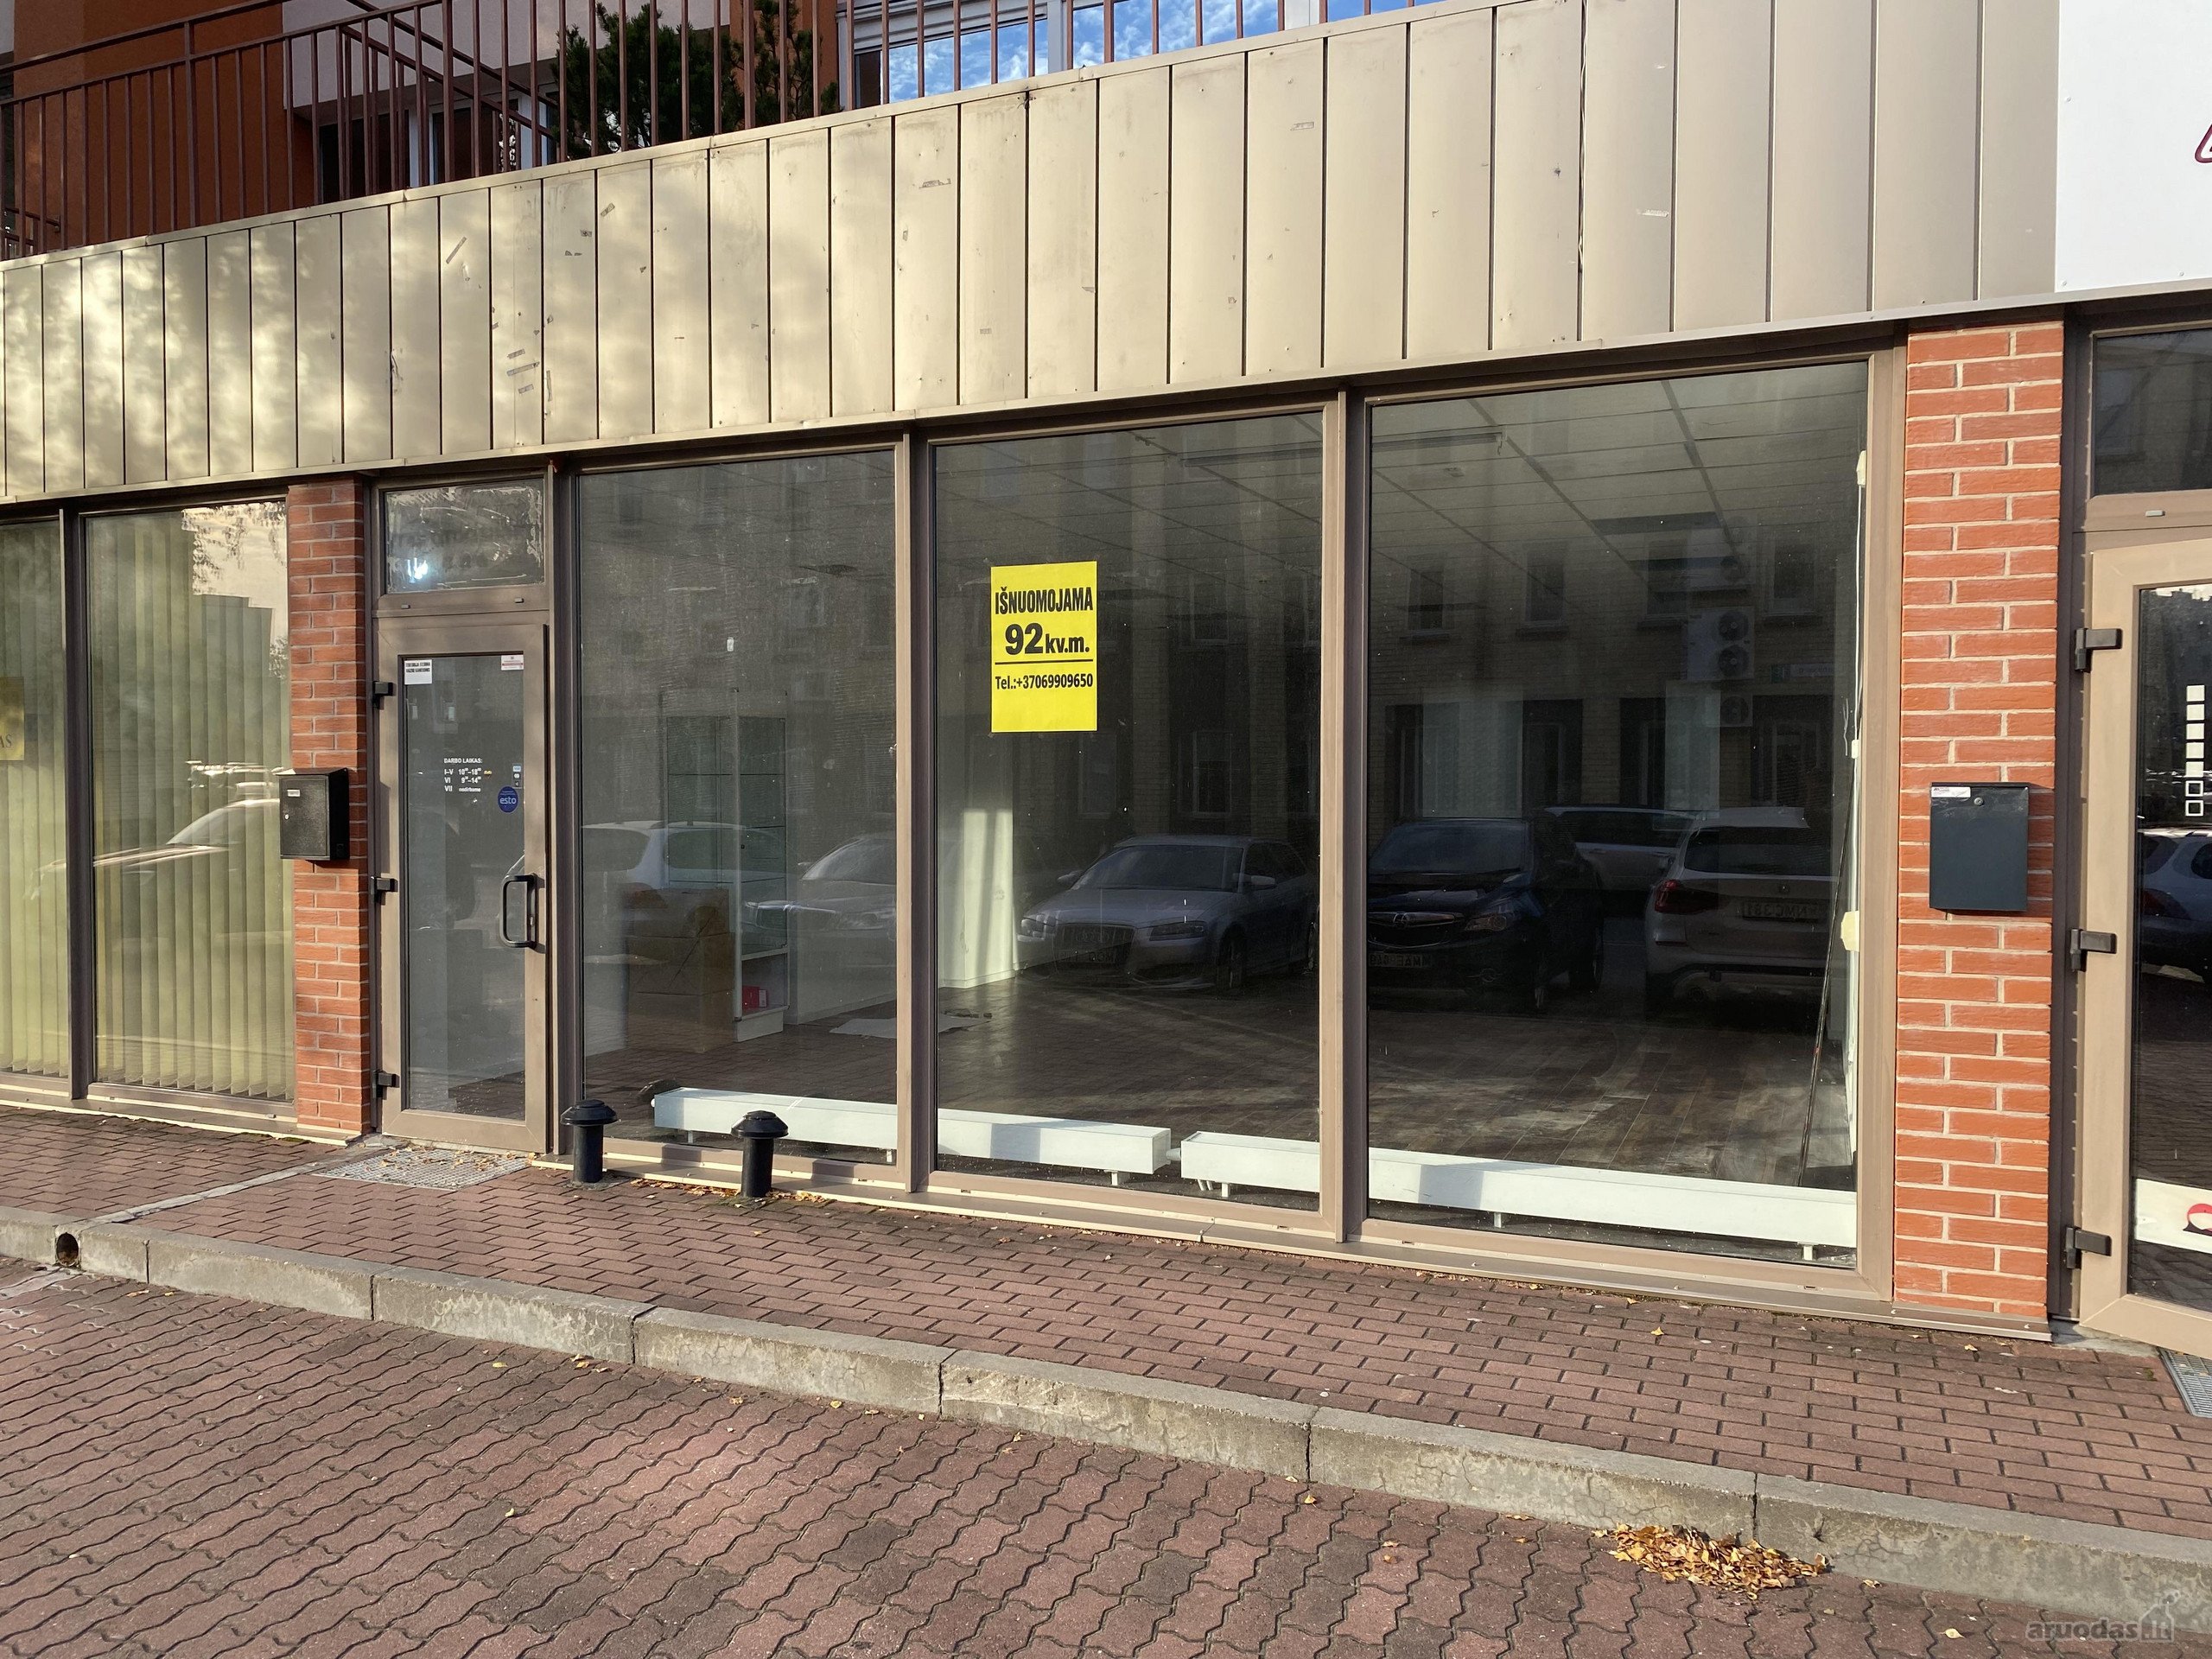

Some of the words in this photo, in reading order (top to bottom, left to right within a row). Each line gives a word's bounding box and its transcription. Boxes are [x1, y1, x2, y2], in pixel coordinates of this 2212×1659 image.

[995, 586, 1094, 615] IŠNUOMOJAMA
[1004, 622, 1044, 656] 92
[1045, 632, 1090, 654] kv.m.
[995, 673, 1093, 690] Tel.:+37069909650
[499, 796, 517, 804] esto
